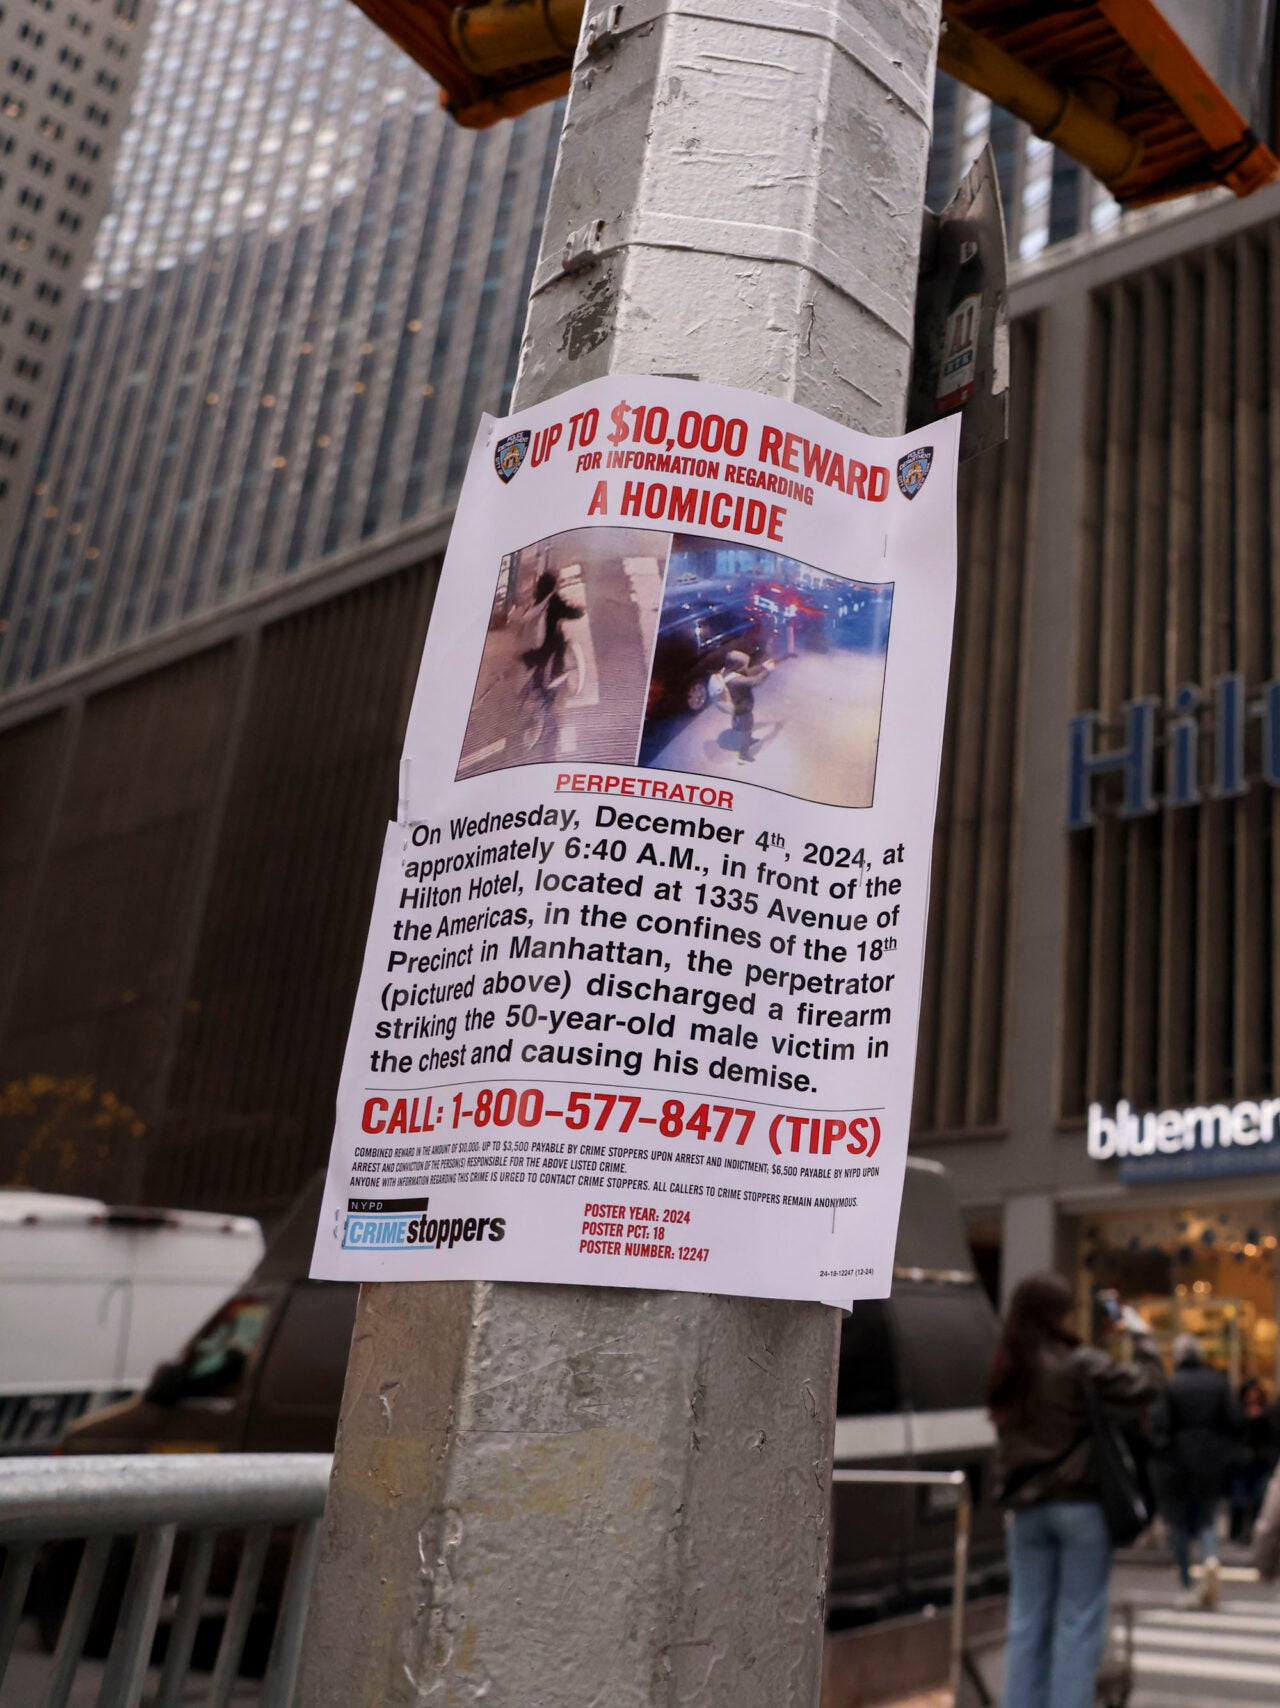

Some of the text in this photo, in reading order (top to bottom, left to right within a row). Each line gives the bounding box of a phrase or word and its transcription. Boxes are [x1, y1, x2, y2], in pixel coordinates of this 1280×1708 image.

[530, 422, 562, 468] UP
[568, 408, 600, 451] TO
[607, 400, 748, 457] $10,000
[758, 425, 890, 502] REWARD
[576, 451, 814, 506] FOR INFORMATION REGARDING
[587, 480, 787, 542] A HOMICIDE
[556, 774, 734, 809] PERPETRATOR
[412, 804, 904, 871] On Wednesday, December 4th, 2024, at
[406, 837, 901, 899] approximately 6:40 A.M., in front of the
[400, 869, 900, 930] Hilton Hotel, located at 1335 Avenue of
[394, 902, 896, 962] the Americas, in the confines of the 18th
[388, 936, 894, 995] Precinct in Manhattan, the perpetrator
[382, 970, 890, 1027] (pictured above) discharged a firearm
[376, 1004, 888, 1060] striking the 50-year-old male victim in
[371, 1039, 816, 1092] the chest and causing his demise.
[361, 1088, 881, 1158] CALL: 1-800-577-8477 (TIPS)
[352, 1162, 381, 1172] ARREST
[382, 1163, 395, 1172] AND
[467, 1156, 508, 1167] RESPONSIBLE
[509, 1157, 524, 1166] FOR
[527, 1157, 541, 1167] THE
[542, 1158, 568, 1169] ABOVE
[570, 1160, 597, 1171] LISTED
[599, 1162, 627, 1173] CRIME.
[355, 1147, 392, 1158] COMBINED
[482, 1141, 490, 1151] UP
[493, 1141, 500, 1151] TO
[503, 1141, 529, 1152] $3,500
[532, 1142, 564, 1153] PAYABLE
[567, 1144, 578, 1154] BY
[580, 1145, 606, 1156] CRIME
[608, 1147, 648, 1159] STOPPERS
[651, 1151, 673, 1161] UPON
[675, 1153, 704, 1164] ARREST
[706, 1156, 722, 1167] AND
[772, 1164, 797, 1176] $6,500
[800, 1168, 831, 1178] PAYABLE
[834, 1169, 842, 1178] BY
[844, 1168, 860, 1178] NYPD
[863, 1167, 879, 1177] UPON
[350, 1177, 380, 1187] ANYONE
[382, 1178, 396, 1187] WITH
[458, 1172, 469, 1182] THIS
[470, 1172, 489, 1182] CRIME
[490, 1172, 498, 1181] IS
[500, 1172, 525, 1182] URGED
[528, 1172, 537, 1183] TO
[540, 1173, 576, 1184] CONTACT
[578, 1176, 604, 1187] CRIME
[607, 1178, 650, 1190] STOPPERS.
[653, 1181, 666, 1192] ALL
[670, 1183, 704, 1195] CALLERS
[706, 1186, 715, 1196] TO
[718, 1188, 741, 1199] CRIME
[743, 1191, 780, 1204] STOPPERS
[783, 1195, 811, 1206] REMAIN
[351, 1201, 383, 1211] NYPD
[584, 1203, 691, 1224] POSTER YEAR: 2024
[579, 1239, 710, 1262] POSTER NUMBER: 12247
[582, 1221, 665, 1240] POSTER PCT: 18
